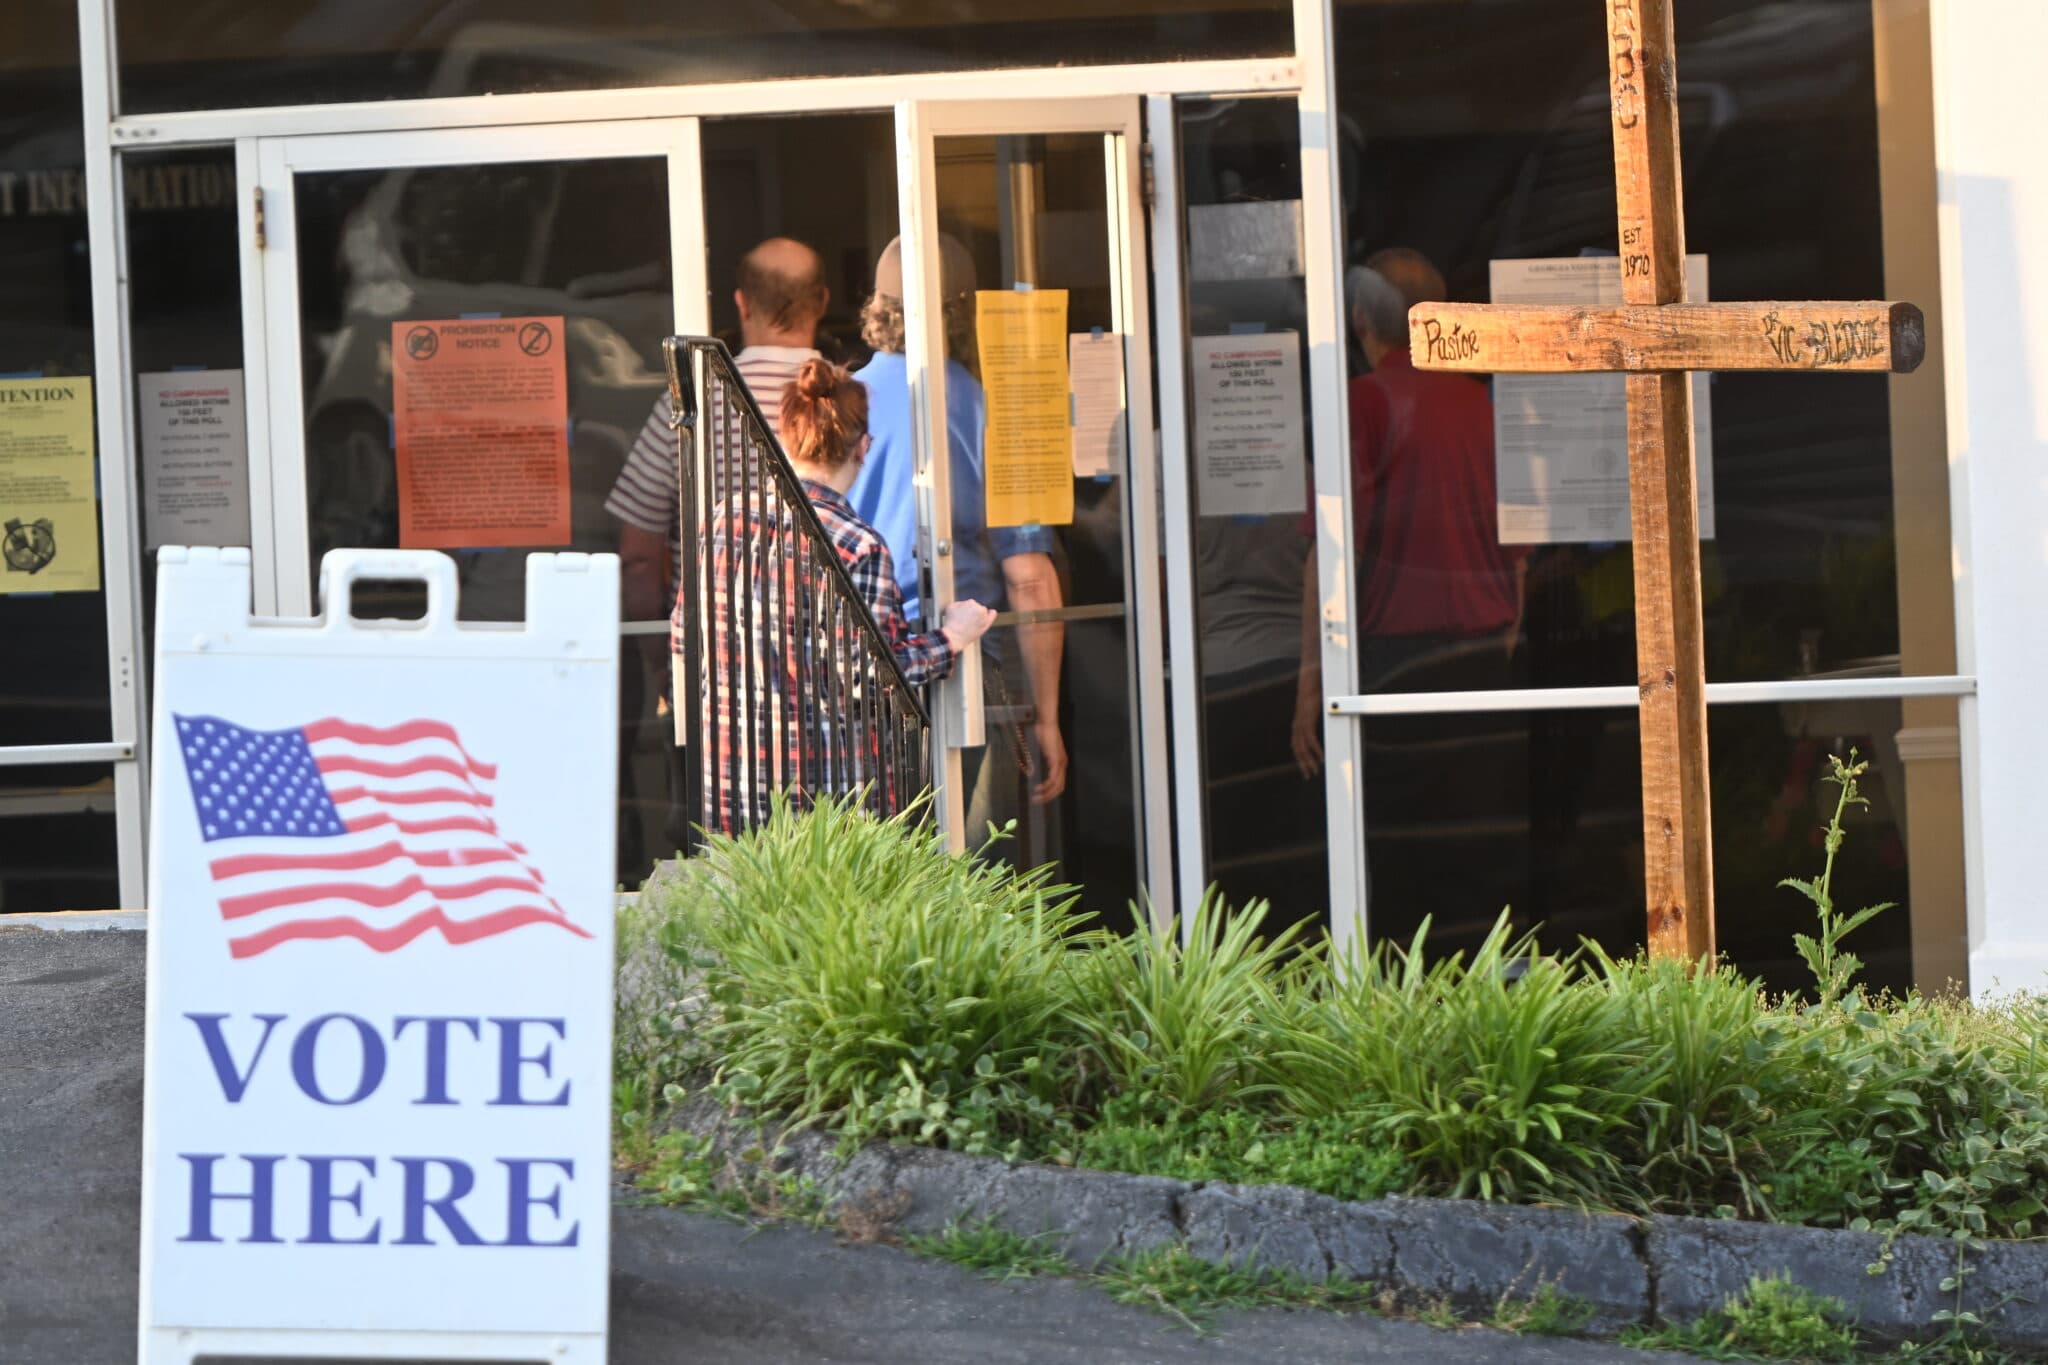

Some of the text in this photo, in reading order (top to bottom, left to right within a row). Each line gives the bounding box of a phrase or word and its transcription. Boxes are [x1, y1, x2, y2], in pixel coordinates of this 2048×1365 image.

[1624, 255, 1650, 277] 1970
[440, 323, 516, 336] PROHIBITION
[456, 338, 501, 349] NOTICE
[0, 387, 75, 402] TENTION
[182, 1012, 571, 1106] VOTE
[175, 1153, 579, 1248] HERE
